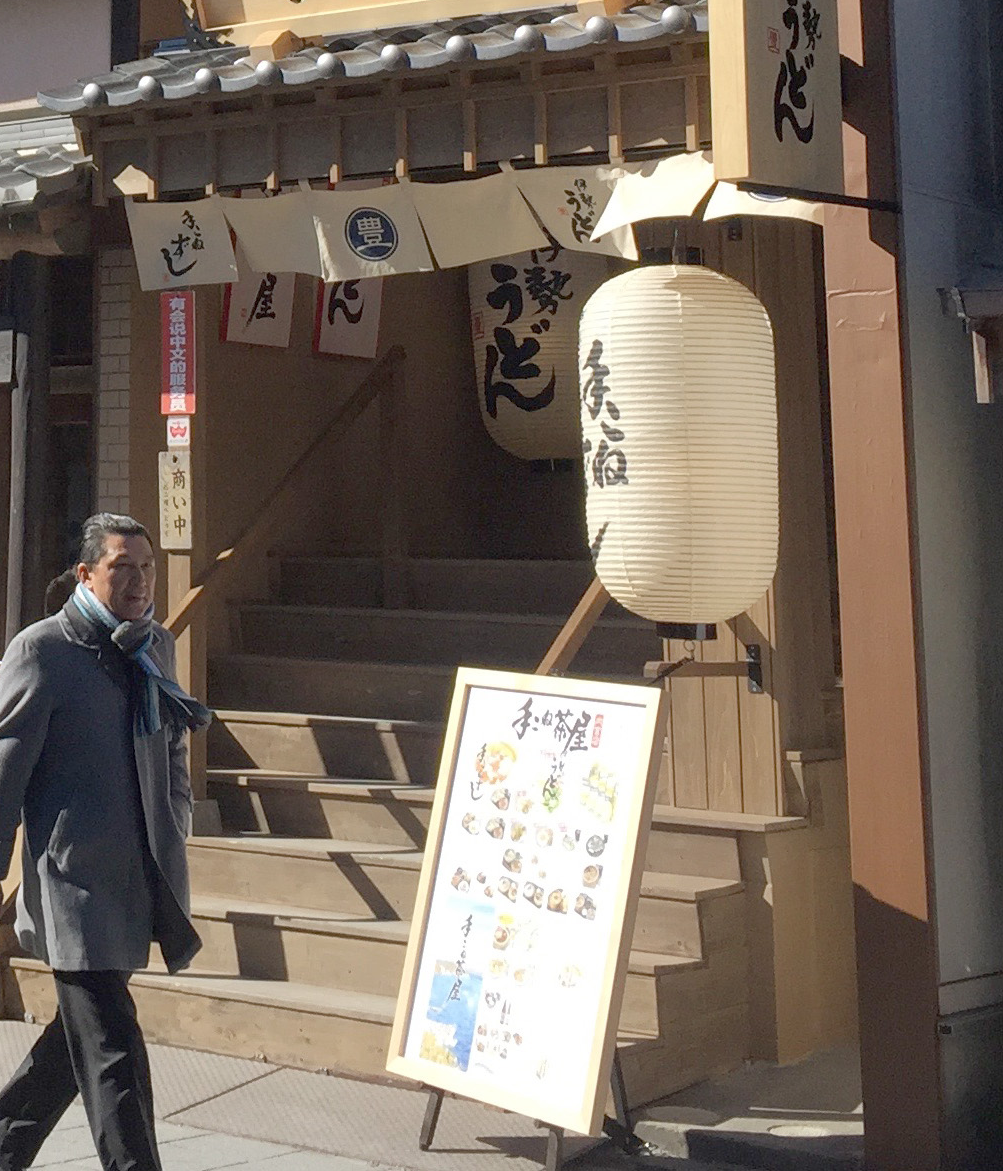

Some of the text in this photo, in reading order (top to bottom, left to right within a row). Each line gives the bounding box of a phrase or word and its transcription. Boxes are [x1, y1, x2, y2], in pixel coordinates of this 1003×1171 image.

[355, 216, 393, 251] 豊
[169, 296, 187, 412] 有会说中文的服务员
[484, 264, 556, 419] うどん
[172, 468, 187, 538] 商い中
[512, 696, 591, 753] 手こね茶屋
